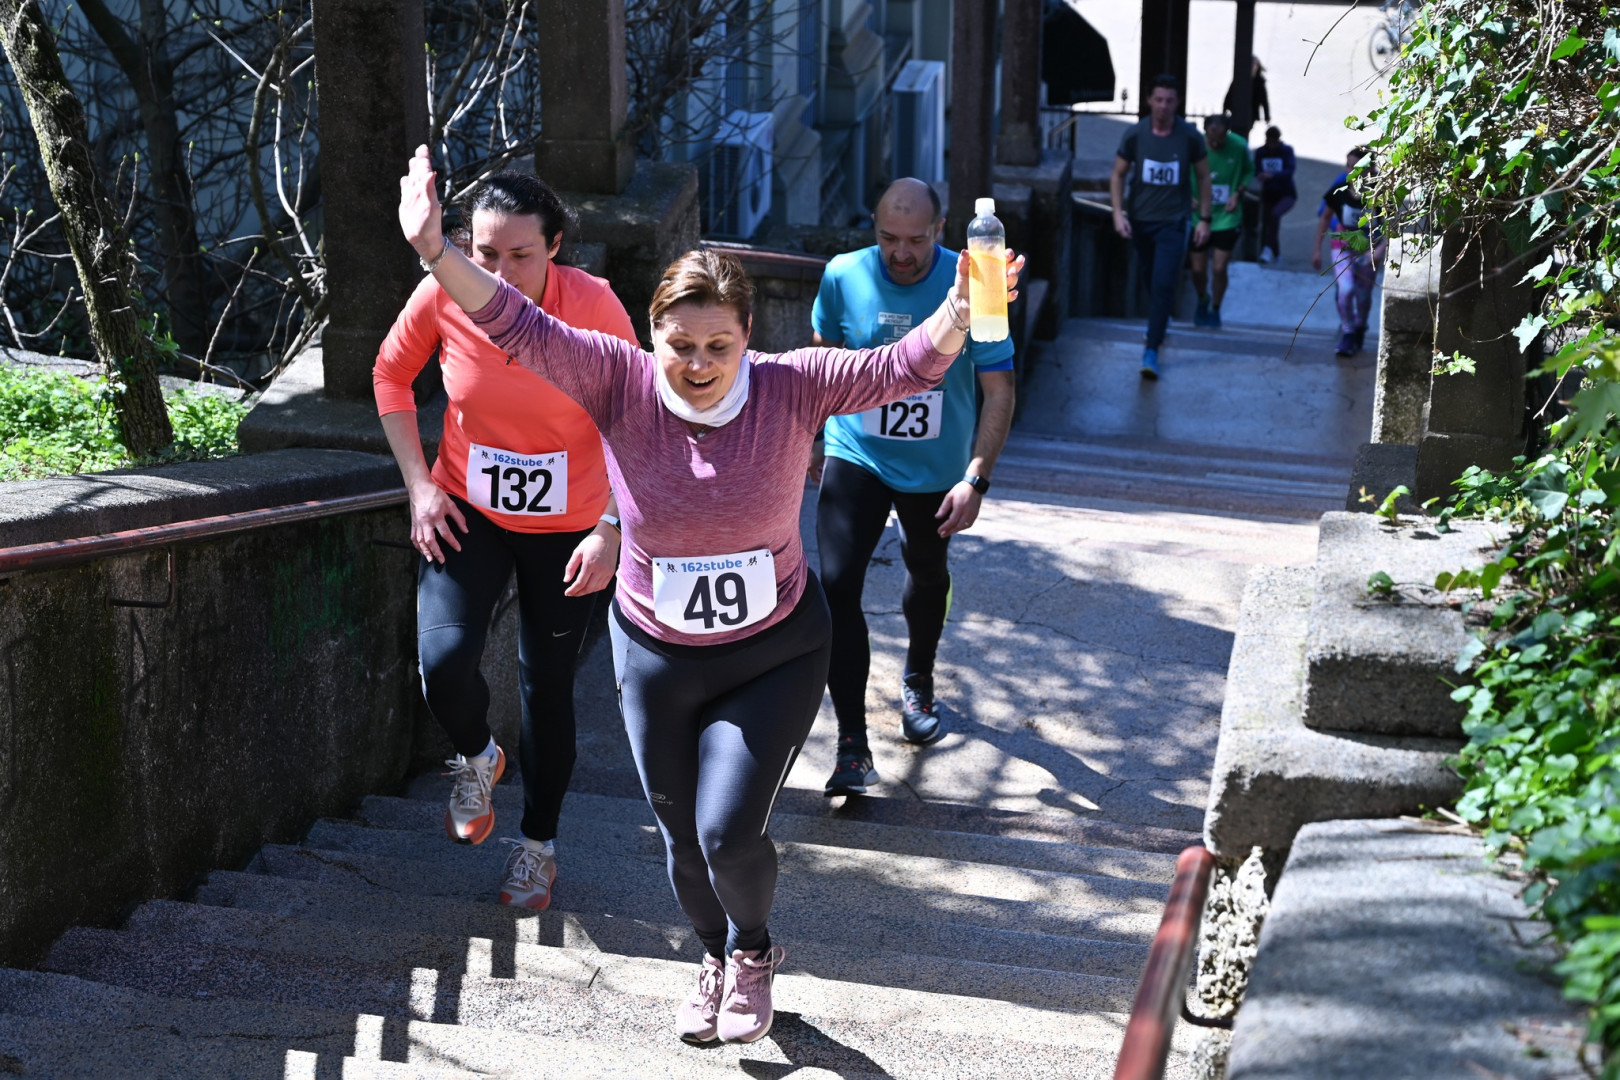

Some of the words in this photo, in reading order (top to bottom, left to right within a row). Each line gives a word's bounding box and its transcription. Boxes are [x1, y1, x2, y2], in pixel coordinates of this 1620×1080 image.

[1148, 167, 1174, 183] 140
[880, 401, 929, 438] 123
[493, 453, 543, 467] 162stube
[481, 464, 553, 513] 132
[681, 559, 743, 573] 162stube
[683, 572, 748, 629] 49
